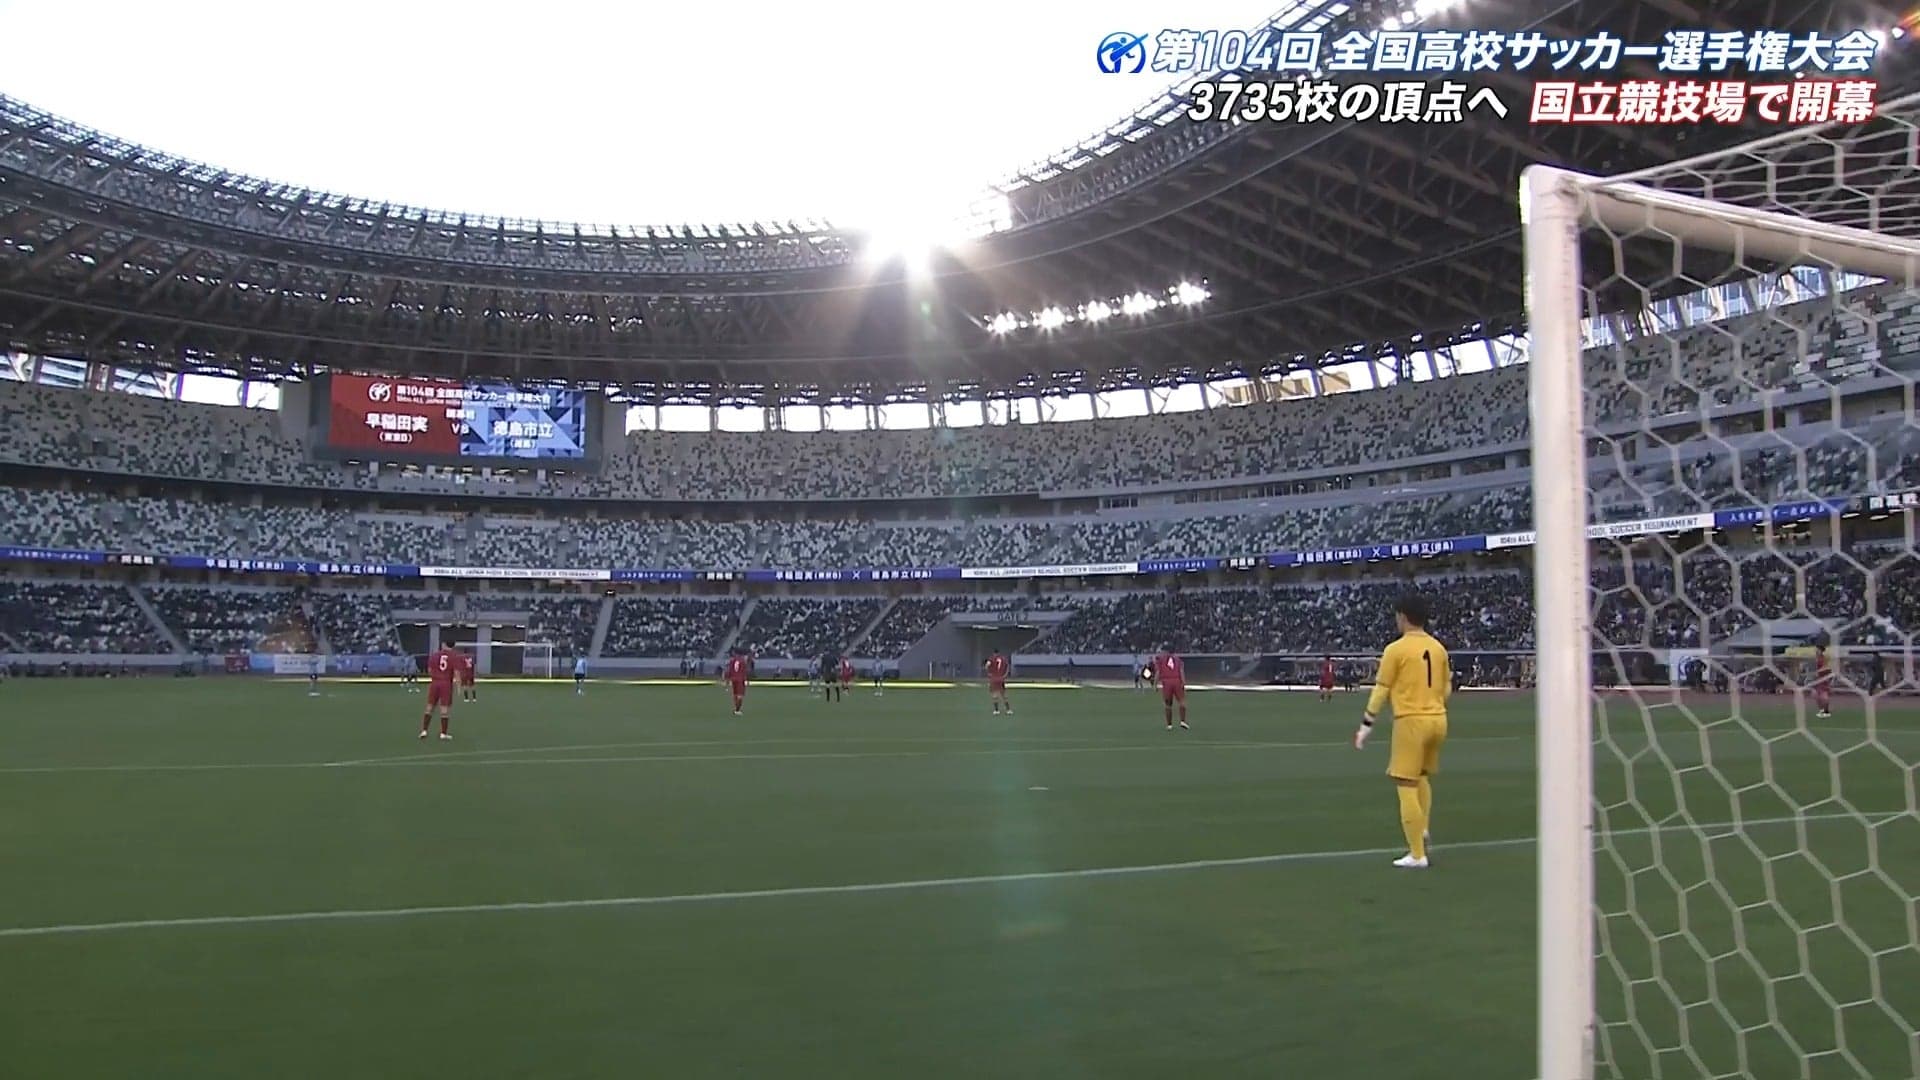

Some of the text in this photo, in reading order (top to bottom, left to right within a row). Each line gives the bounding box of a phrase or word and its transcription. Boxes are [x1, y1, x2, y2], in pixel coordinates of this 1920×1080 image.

[439, 654, 449, 671] 5
[1166, 656, 1175, 670] 4
[1422, 649, 1432, 689] 1
